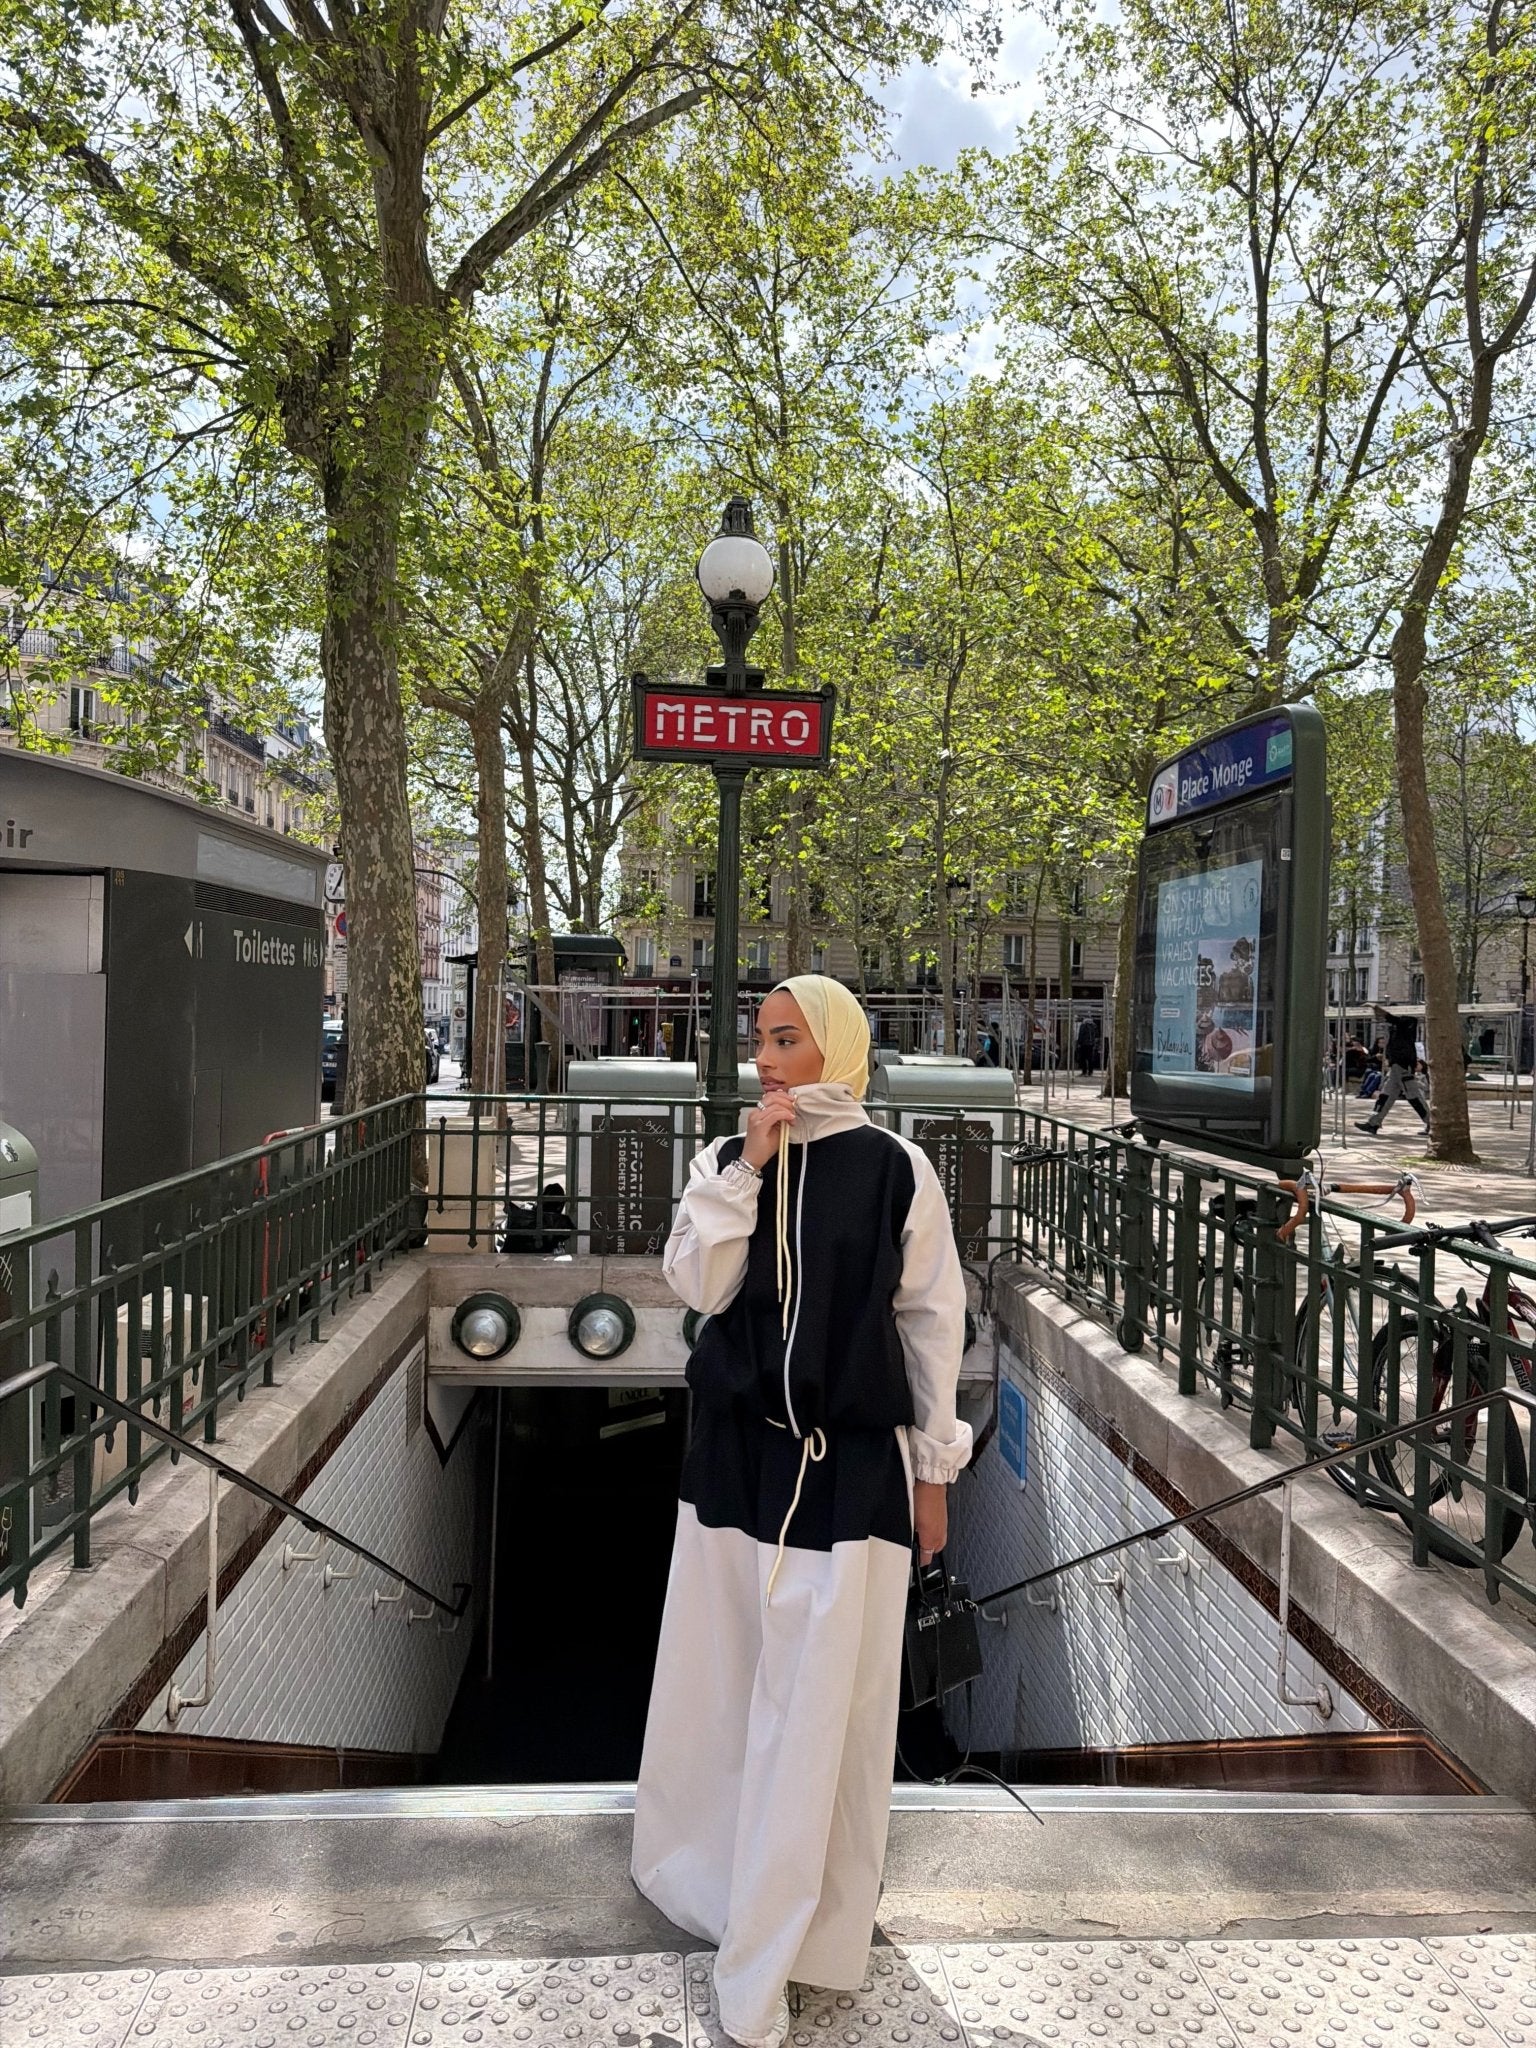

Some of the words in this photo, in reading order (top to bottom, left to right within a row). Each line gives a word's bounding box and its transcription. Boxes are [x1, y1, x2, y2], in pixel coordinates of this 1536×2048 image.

[656, 702, 810, 746] METRO
[1181, 776, 1209, 800] Place
[1212, 756, 1253, 790] Monge
[0, 820, 33, 848] ir
[1162, 889, 1178, 914] ON
[1162, 917, 1183, 938] VITE
[1184, 914, 1205, 936] AUX
[233, 929, 296, 967] Toilettes
[1161, 940, 1193, 962] VRAIES
[1160, 964, 1212, 987] VACANCES
[618, 1150, 628, 1190] DÉCHETS
